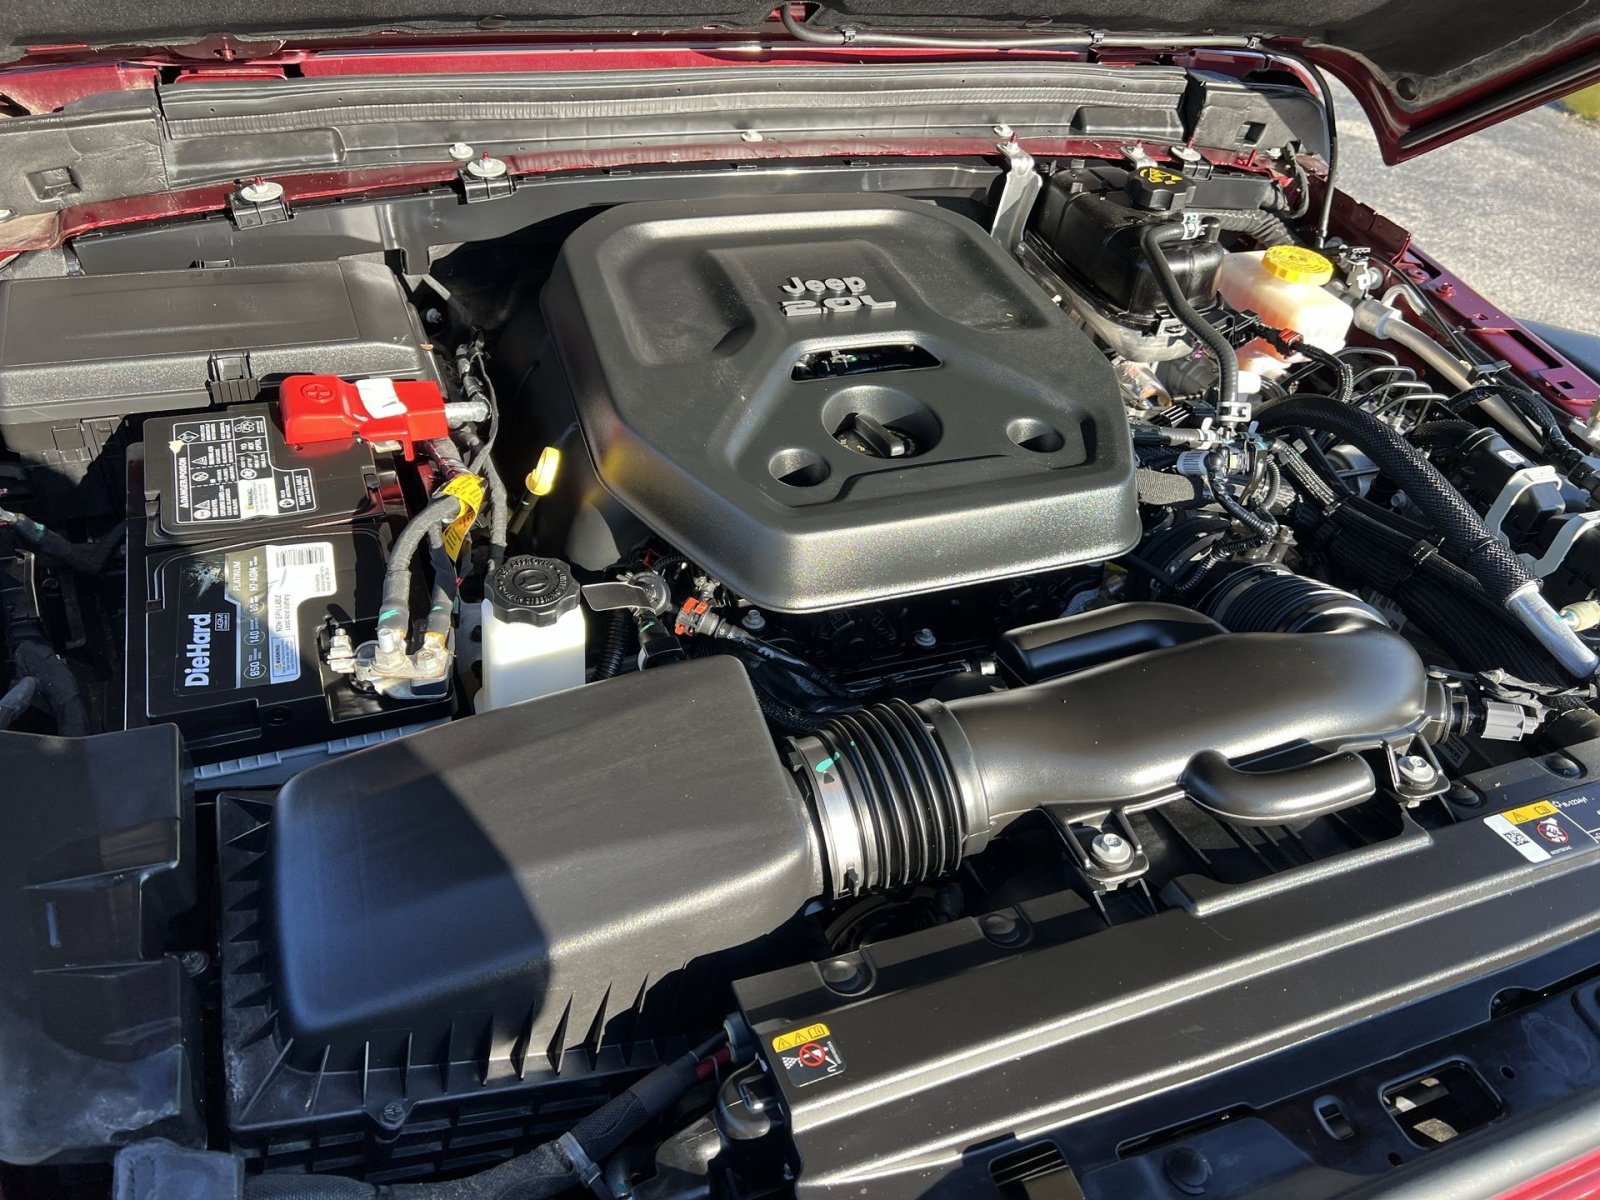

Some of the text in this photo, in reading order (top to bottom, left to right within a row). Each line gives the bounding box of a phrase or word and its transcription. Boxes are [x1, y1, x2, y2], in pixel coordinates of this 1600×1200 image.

[781, 276, 867, 296] Jeep
[781, 294, 898, 317] 2.0L
[232, 560, 241, 591] PLATINUM
[216, 614, 224, 629] AGM
[249, 630, 259, 643] 140
[184, 613, 211, 687] DieHard
[249, 661, 260, 677] 850
